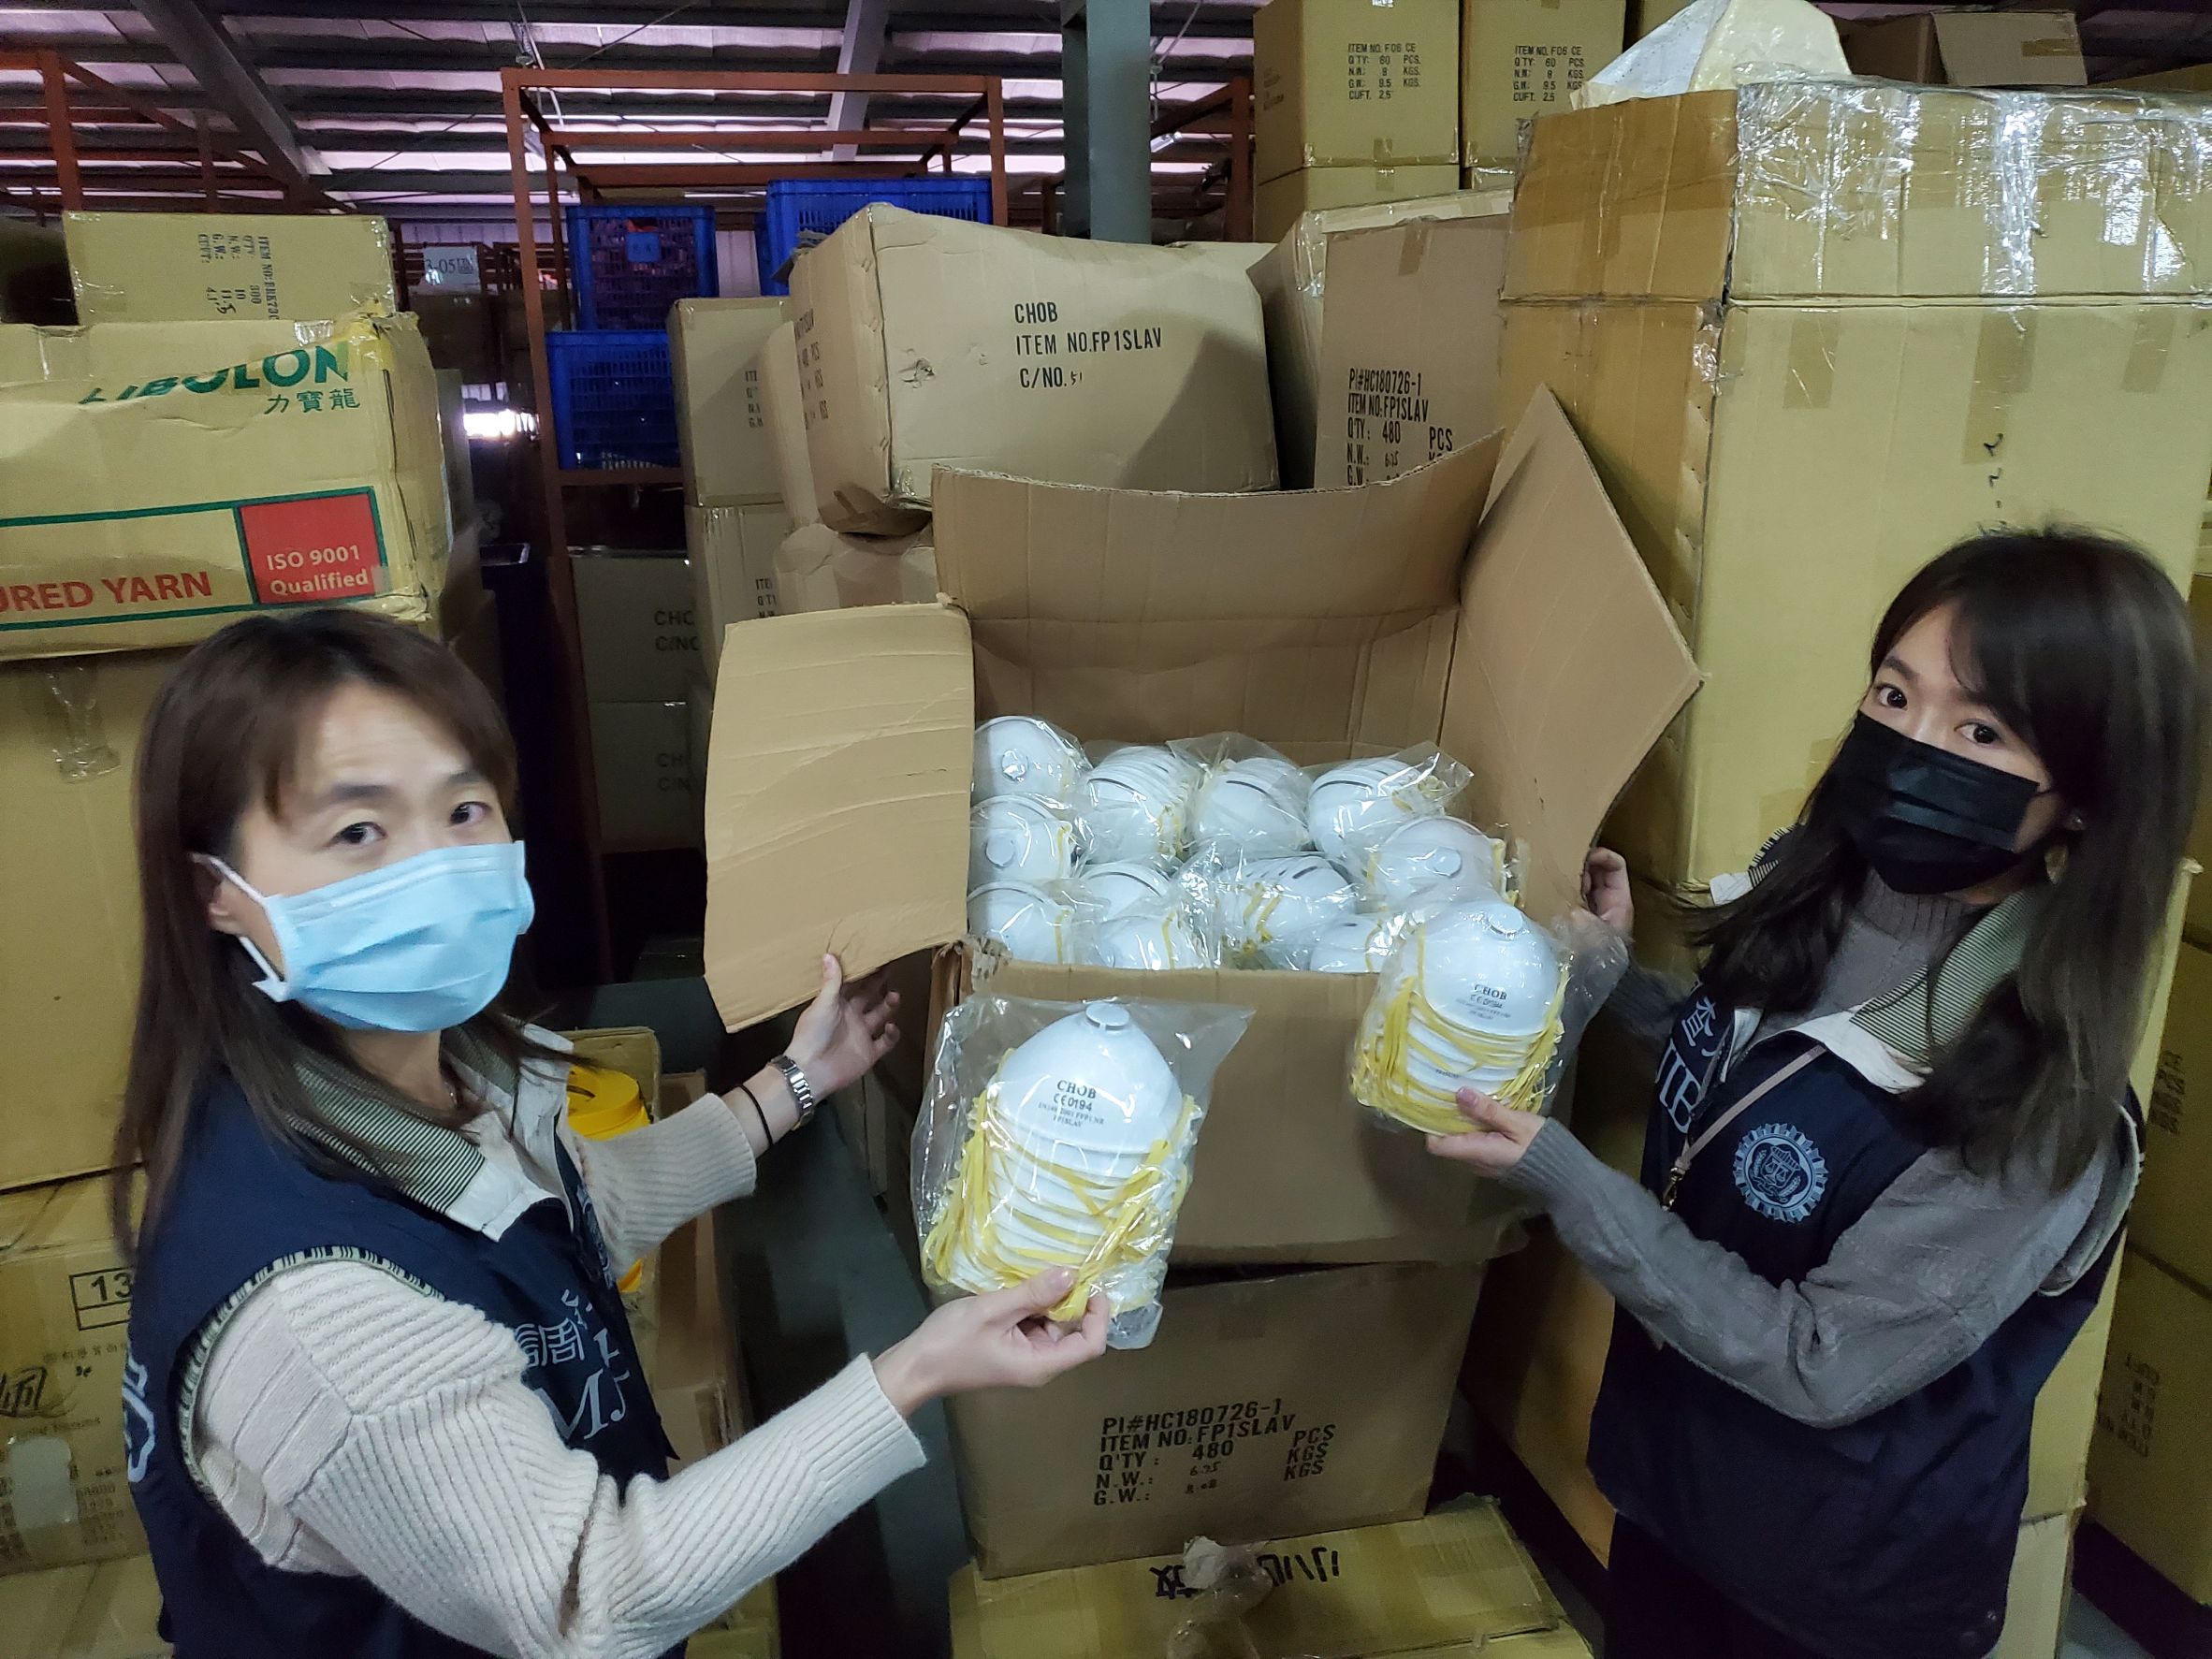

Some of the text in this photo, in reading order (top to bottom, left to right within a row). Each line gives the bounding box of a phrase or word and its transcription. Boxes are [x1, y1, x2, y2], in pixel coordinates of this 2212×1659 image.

[1348, 43, 1368, 53] ITEM
[1405, 42, 1417, 53] CE
[1515, 45, 1535, 55] ITEM
[1571, 46, 1583, 56] CE
[1013, 301, 1058, 324] CHOB
[1016, 334, 1057, 356] ITEM
[263, 387, 360, 415] 力寶龍
[1347, 392, 1367, 415] ITEM
[1382, 420, 1401, 444] 480
[1429, 426, 1453, 452] PCS
[266, 544, 361, 571] ISO 9001
[100, 570, 213, 605] YARN
[269, 567, 369, 596] Qualified
[1056, 1080, 1097, 1099] CHOB
[1102, 1397, 1283, 1435] PI#HC180726-1
[1100, 1433, 1150, 1452] ITEM
[1192, 1439, 1234, 1461] 480
[1292, 1423, 1337, 1448] PCS
[1287, 1442, 1329, 1464] KGS
[1283, 1460, 1325, 1481] KGS
